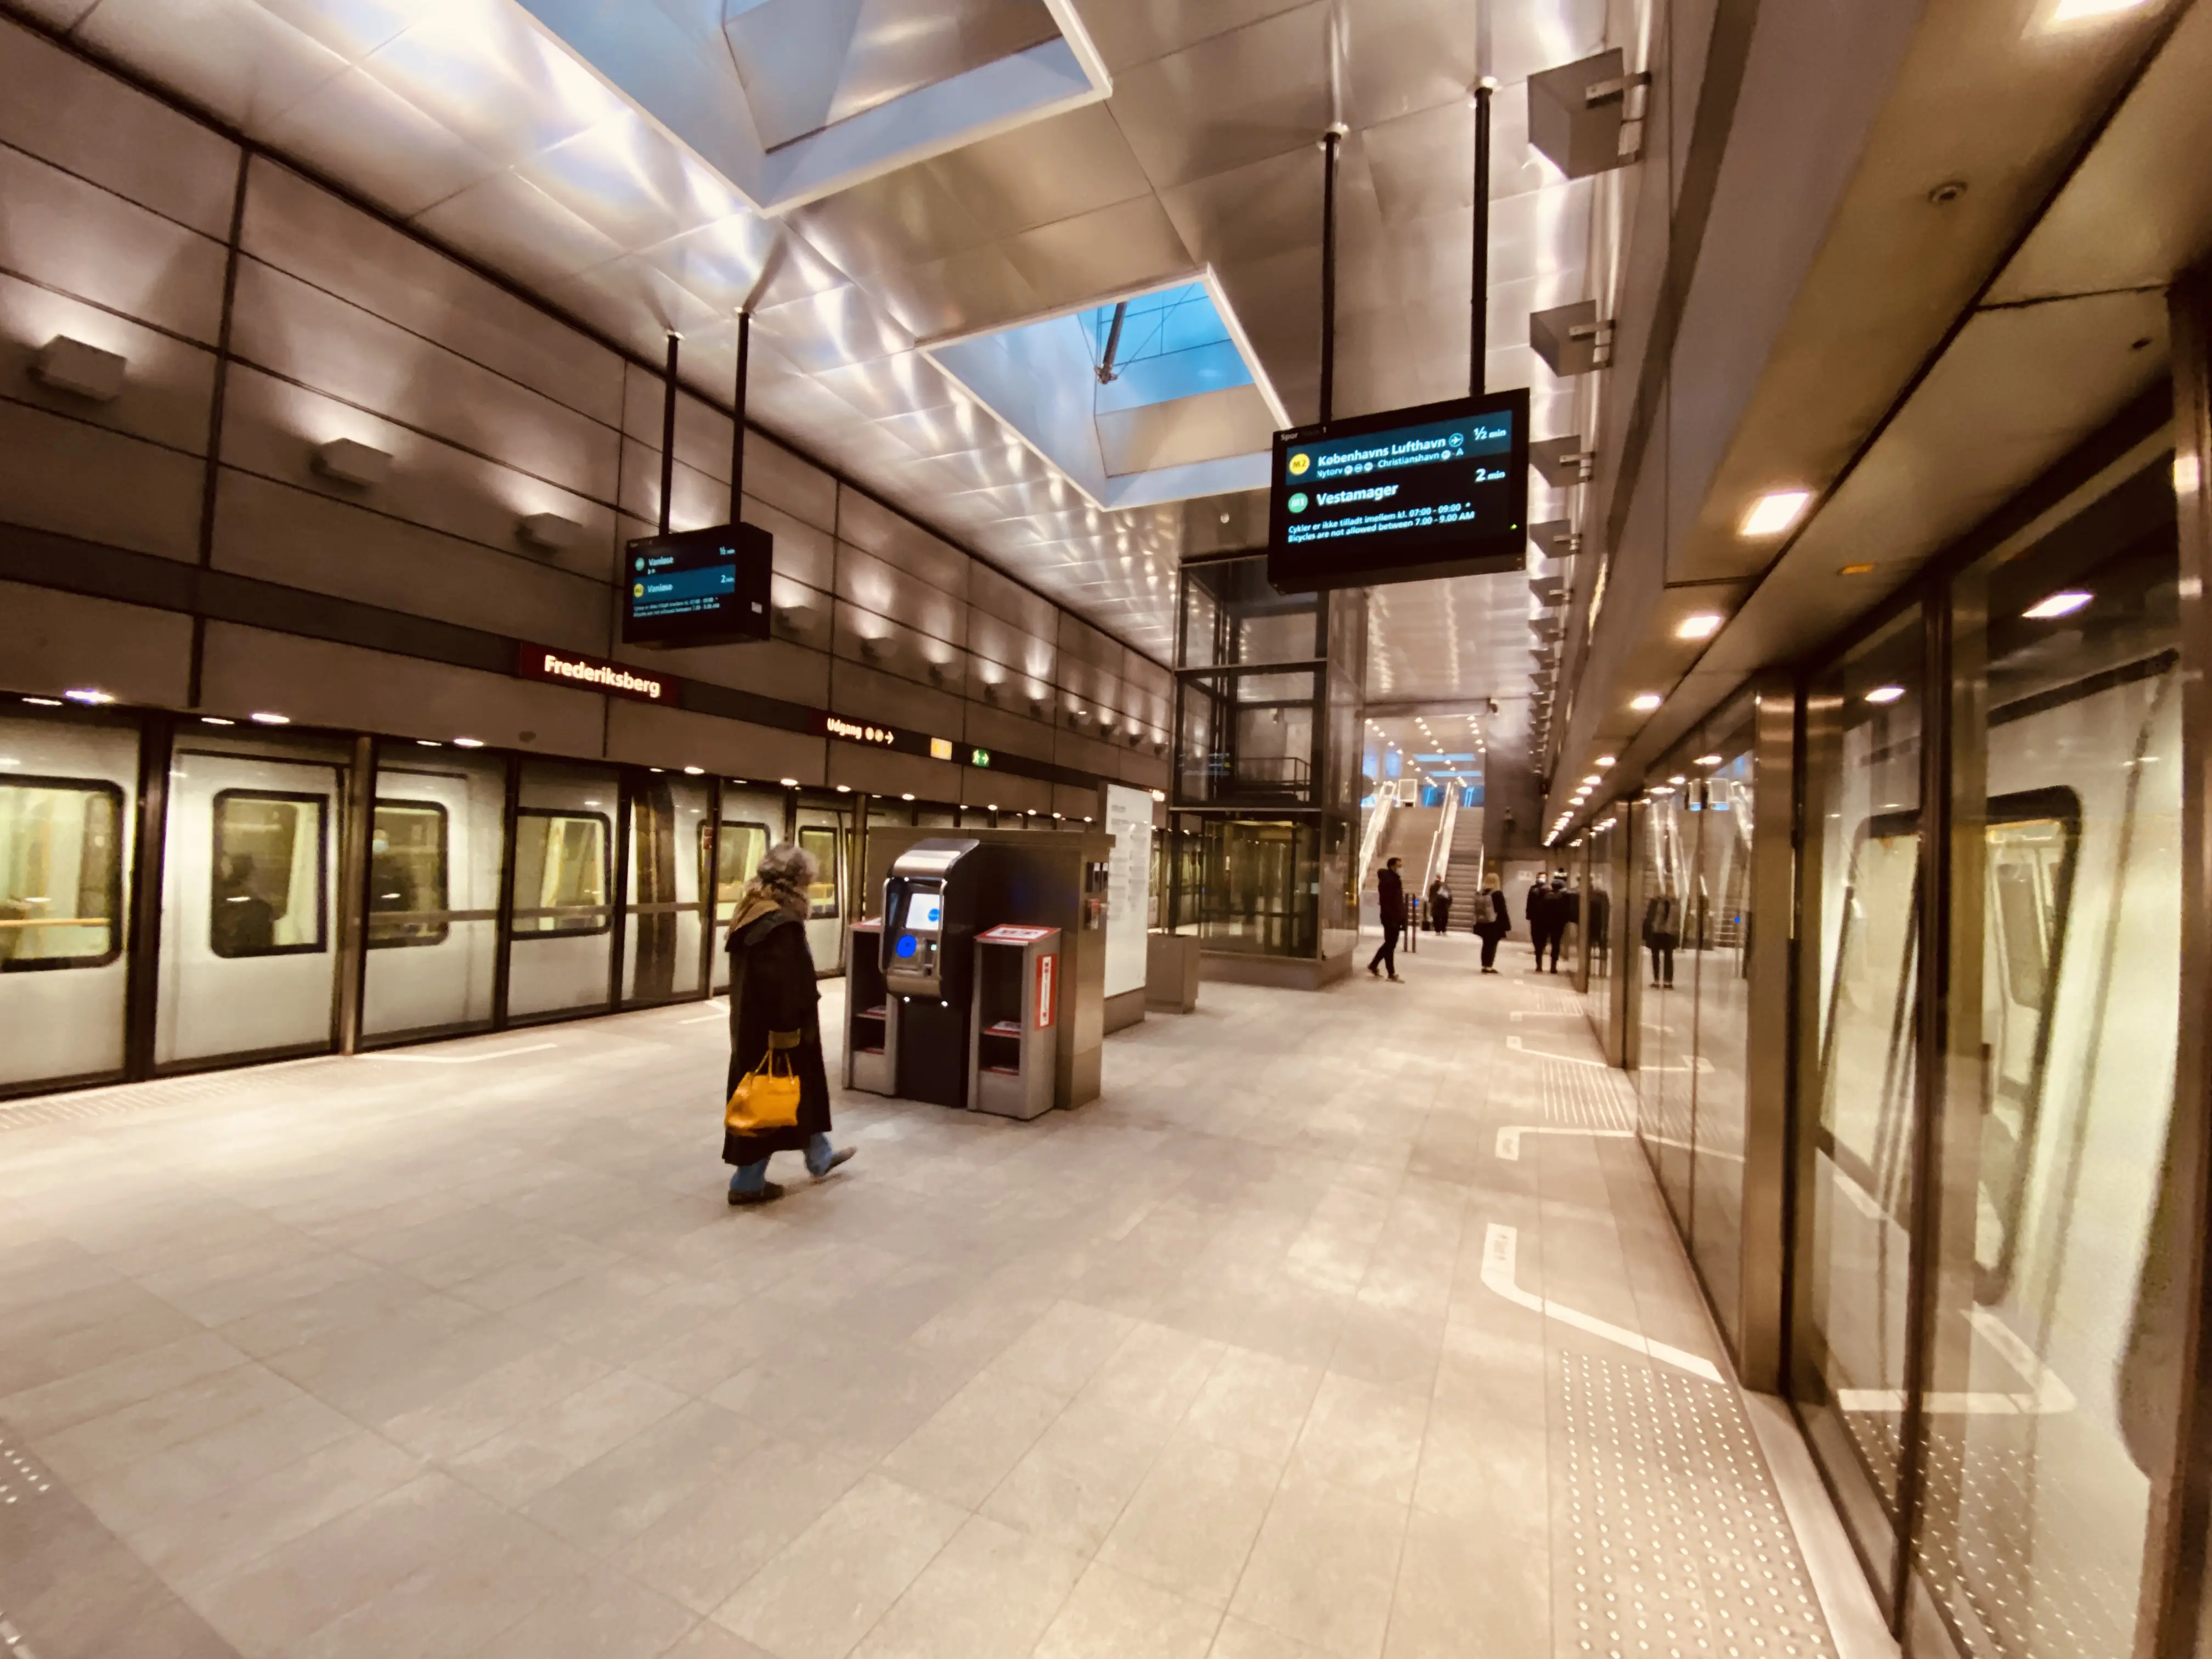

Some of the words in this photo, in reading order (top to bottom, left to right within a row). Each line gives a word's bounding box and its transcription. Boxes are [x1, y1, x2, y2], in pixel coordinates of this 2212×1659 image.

[1489, 428, 1506, 438] min
[1318, 447, 1389, 466] Københavns
[1392, 438, 1446, 455] Lufthavn
[1378, 452, 1439, 469] Christianshavn
[1293, 459, 1306, 469] M2
[1476, 468, 1486, 482] 2
[1487, 470, 1505, 479] min
[1317, 484, 1398, 506] Vestamager
[1288, 524, 1311, 534] Cykler
[1322, 521, 1338, 529] ikke
[1340, 517, 1362, 526] tilladt
[1409, 507, 1431, 517] 07:00
[1438, 503, 1461, 514] 09:00
[1288, 533, 1316, 543] Bicycles
[1331, 528, 1344, 537] not
[1346, 524, 1376, 535] allowed
[1378, 520, 1413, 531] between
[1459, 511, 1475, 520] AM
[545, 655, 660, 698] Frederiksberg
[827, 718, 862, 740] Udgang
